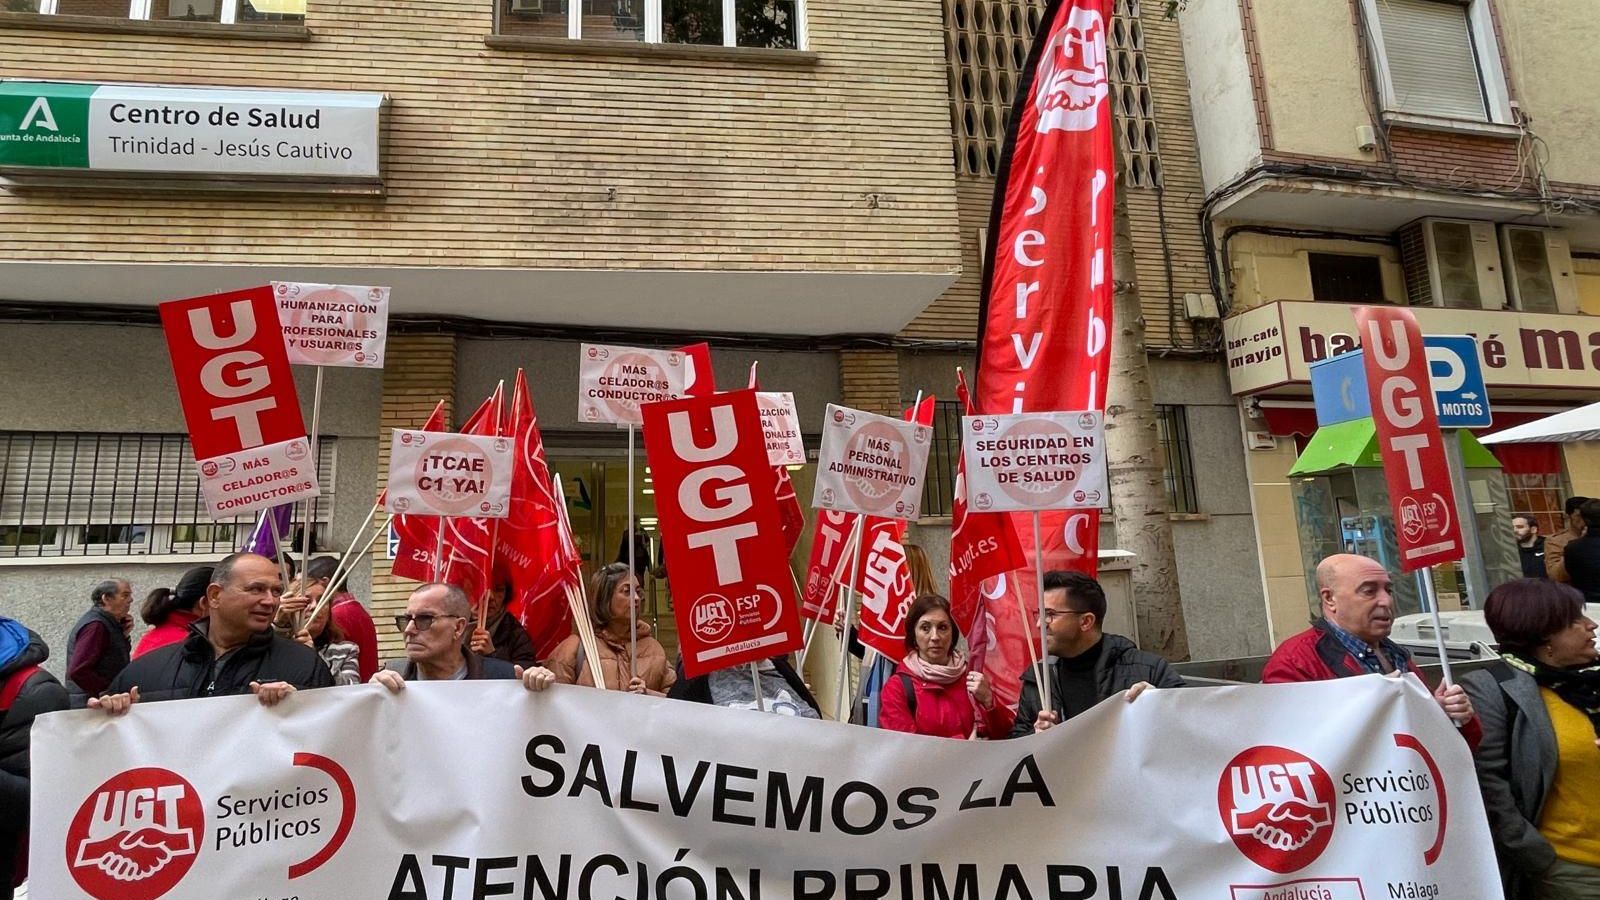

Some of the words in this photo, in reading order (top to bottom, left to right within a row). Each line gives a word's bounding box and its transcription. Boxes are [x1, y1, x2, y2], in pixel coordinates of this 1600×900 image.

[109, 103, 200, 124] Centro
[208, 106, 240, 126] de
[248, 108, 320, 129] Salud
[22, 134, 34, 142] de
[36, 134, 80, 143] Andalucía
[109, 136, 195, 155] Trinidad
[214, 138, 270, 158] Jesús
[276, 141, 353, 160] Cautivo
[280, 300, 377, 314] HUMANIZACIÓN
[311, 314, 344, 324] PARA
[288, 339, 296, 347] Y
[300, 340, 362, 350] USUARI@S
[1228, 326, 1279, 350] bar-café
[1230, 346, 1282, 368] mayjo
[187, 300, 277, 450] UGT
[622, 364, 647, 375] MÁS
[598, 376, 669, 390] CELADOR@S
[1424, 346, 1466, 416] P
[588, 389, 678, 401] CONDUCTOR@S
[1368, 319, 1430, 490] UGT
[1442, 402, 1482, 416] MOTOS
[868, 438, 890, 452] MÁS
[976, 438, 1068, 452] SEGURIDAD
[1073, 436, 1094, 448] EN
[242, 457, 270, 470] MÁS
[422, 456, 484, 472] ¡TCAE
[848, 450, 902, 470] PERSONAL
[981, 456, 1011, 468] LOS
[1016, 453, 1092, 466] CENTROS
[222, 468, 298, 492] CELADOR@S
[829, 462, 916, 486] ADMINISTRATIVO
[998, 472, 1018, 484] DE
[1024, 470, 1076, 482] SALUD
[216, 481, 312, 510] CONDUCTOR@S
[418, 476, 443, 491] C1
[452, 478, 485, 494] YA!
[666, 404, 758, 586] UGT
[1423, 502, 1436, 516] FSP
[950, 536, 998, 577] .ugt.es
[696, 600, 728, 624] UGT
[736, 594, 760, 612] FSP
[725, 640, 761, 654] Andalucía
[520, 734, 940, 836] SALVEMOS
[958, 754, 1056, 811] LA
[1230, 762, 1318, 809] UGT
[1342, 770, 1430, 796] Servicios
[88, 784, 186, 838] UGT
[216, 786, 329, 820] Servicios
[1344, 801, 1433, 825] Públicos
[216, 815, 322, 851] Públicos
[387, 848, 761, 900] ATENCIÓN
[1263, 884, 1332, 900] Andalucía
[1387, 881, 1440, 900] Málaga
